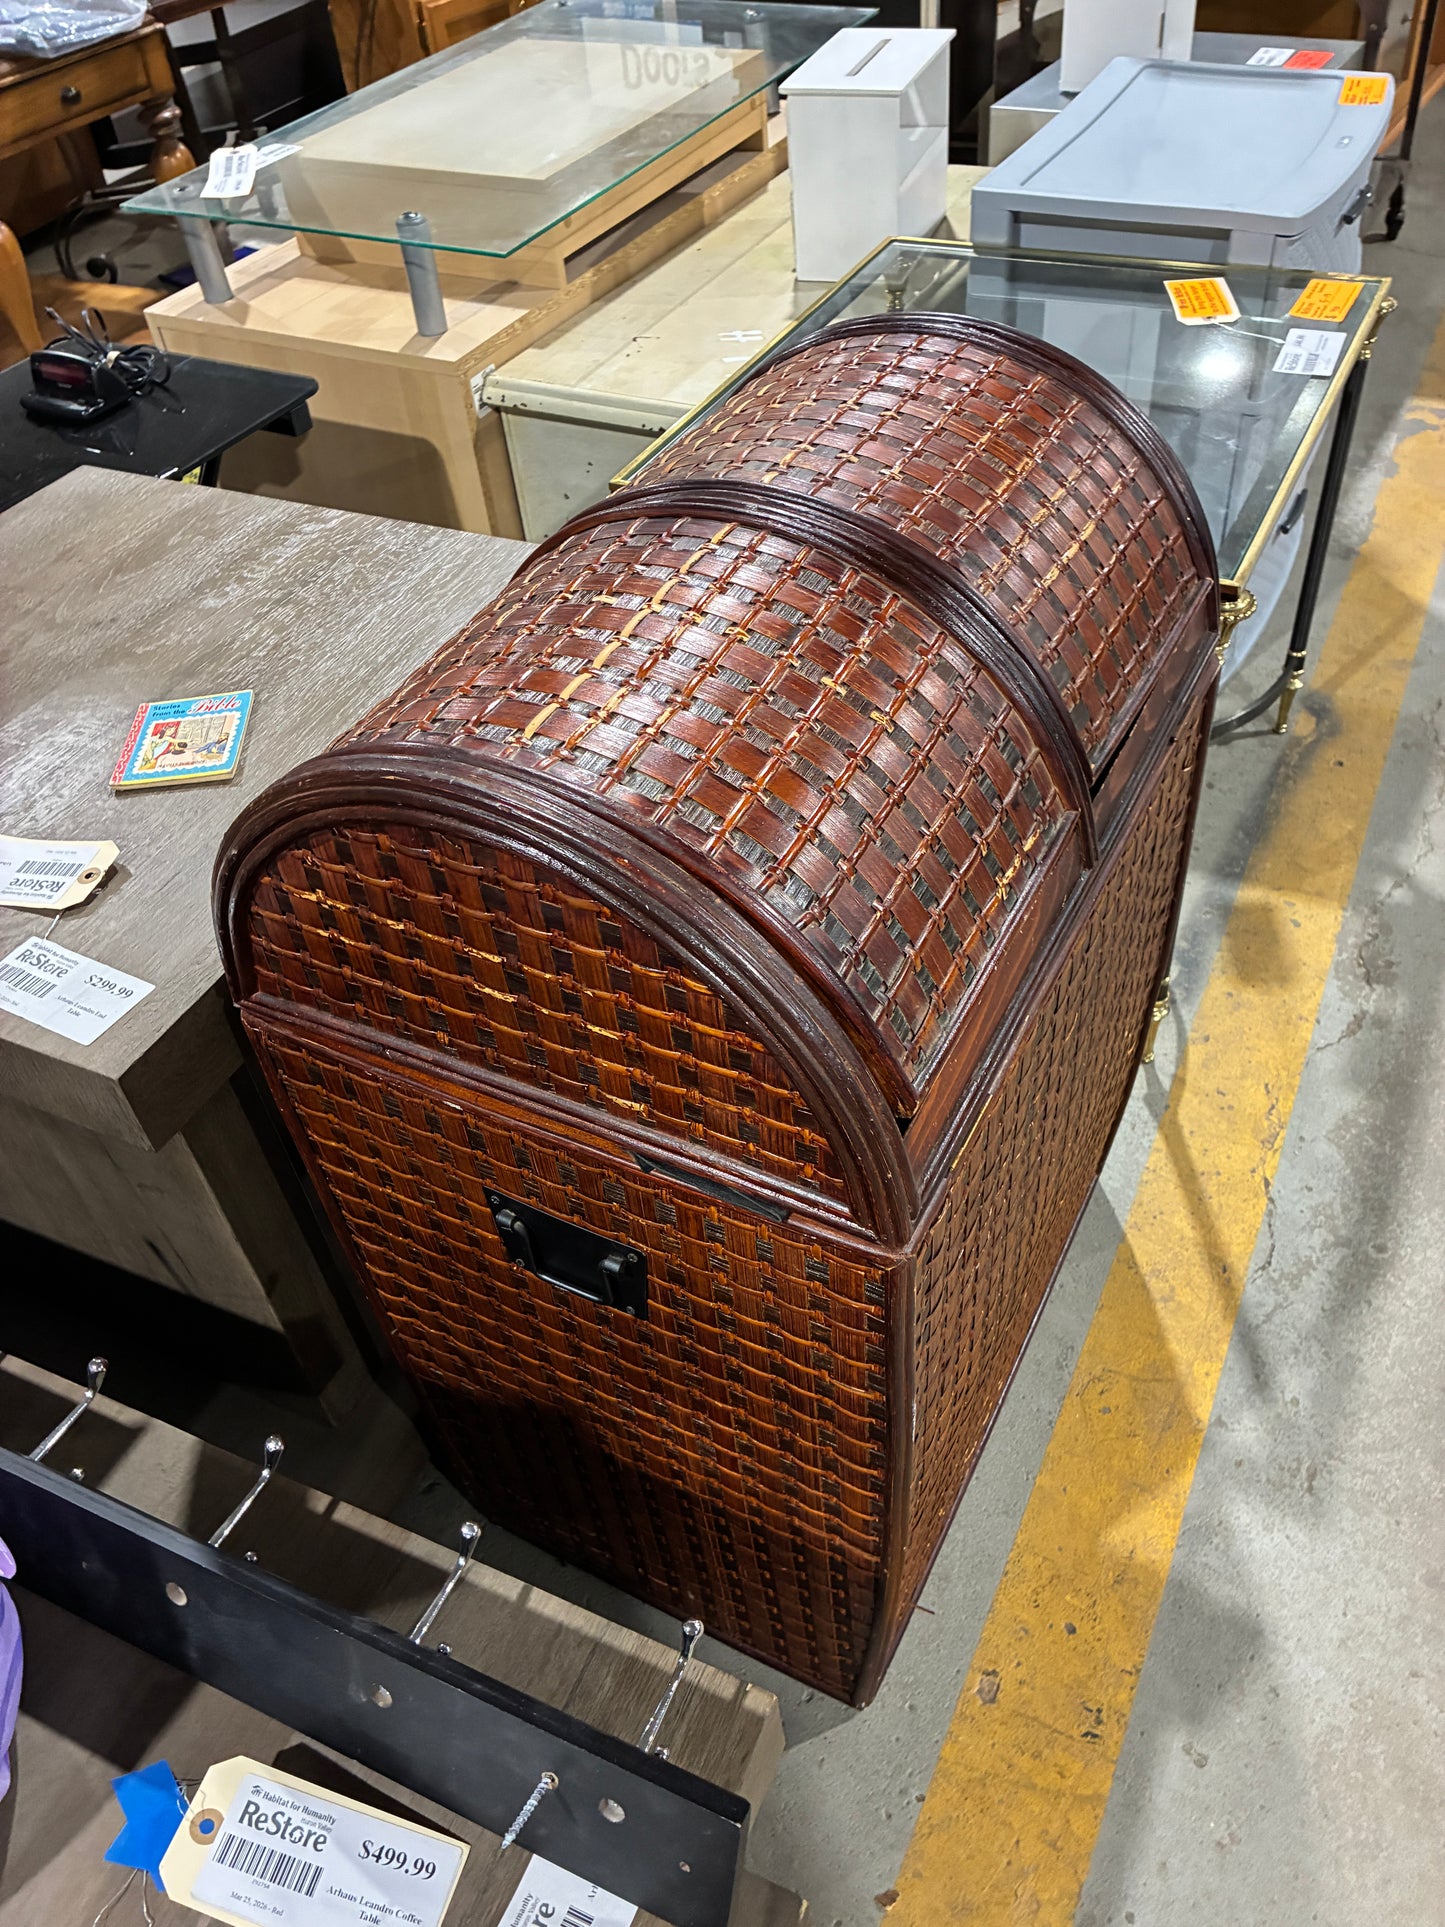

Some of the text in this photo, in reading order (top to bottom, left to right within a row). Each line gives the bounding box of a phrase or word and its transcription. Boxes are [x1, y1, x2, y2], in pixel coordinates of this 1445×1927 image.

[152, 704, 181, 712] Stories
[152, 710, 171, 718] from
[187, 695, 241, 714] Bible
[9, 877, 66, 893] ReStore
[15, 948, 69, 978] ReStore
[84, 974, 134, 999] $299.99
[262, 1791, 337, 1826] Habitat for Humanity
[238, 1799, 327, 1852] ReStore
[317, 1821, 333, 1834] Valley
[358, 1839, 436, 1880] $499.99
[230, 1891, 243, 1901] Mar
[271, 1906, 284, 1916] Red
[326, 1885, 422, 1926] Arhaus Leandro Coffee
[359, 1910, 381, 1926] Table
